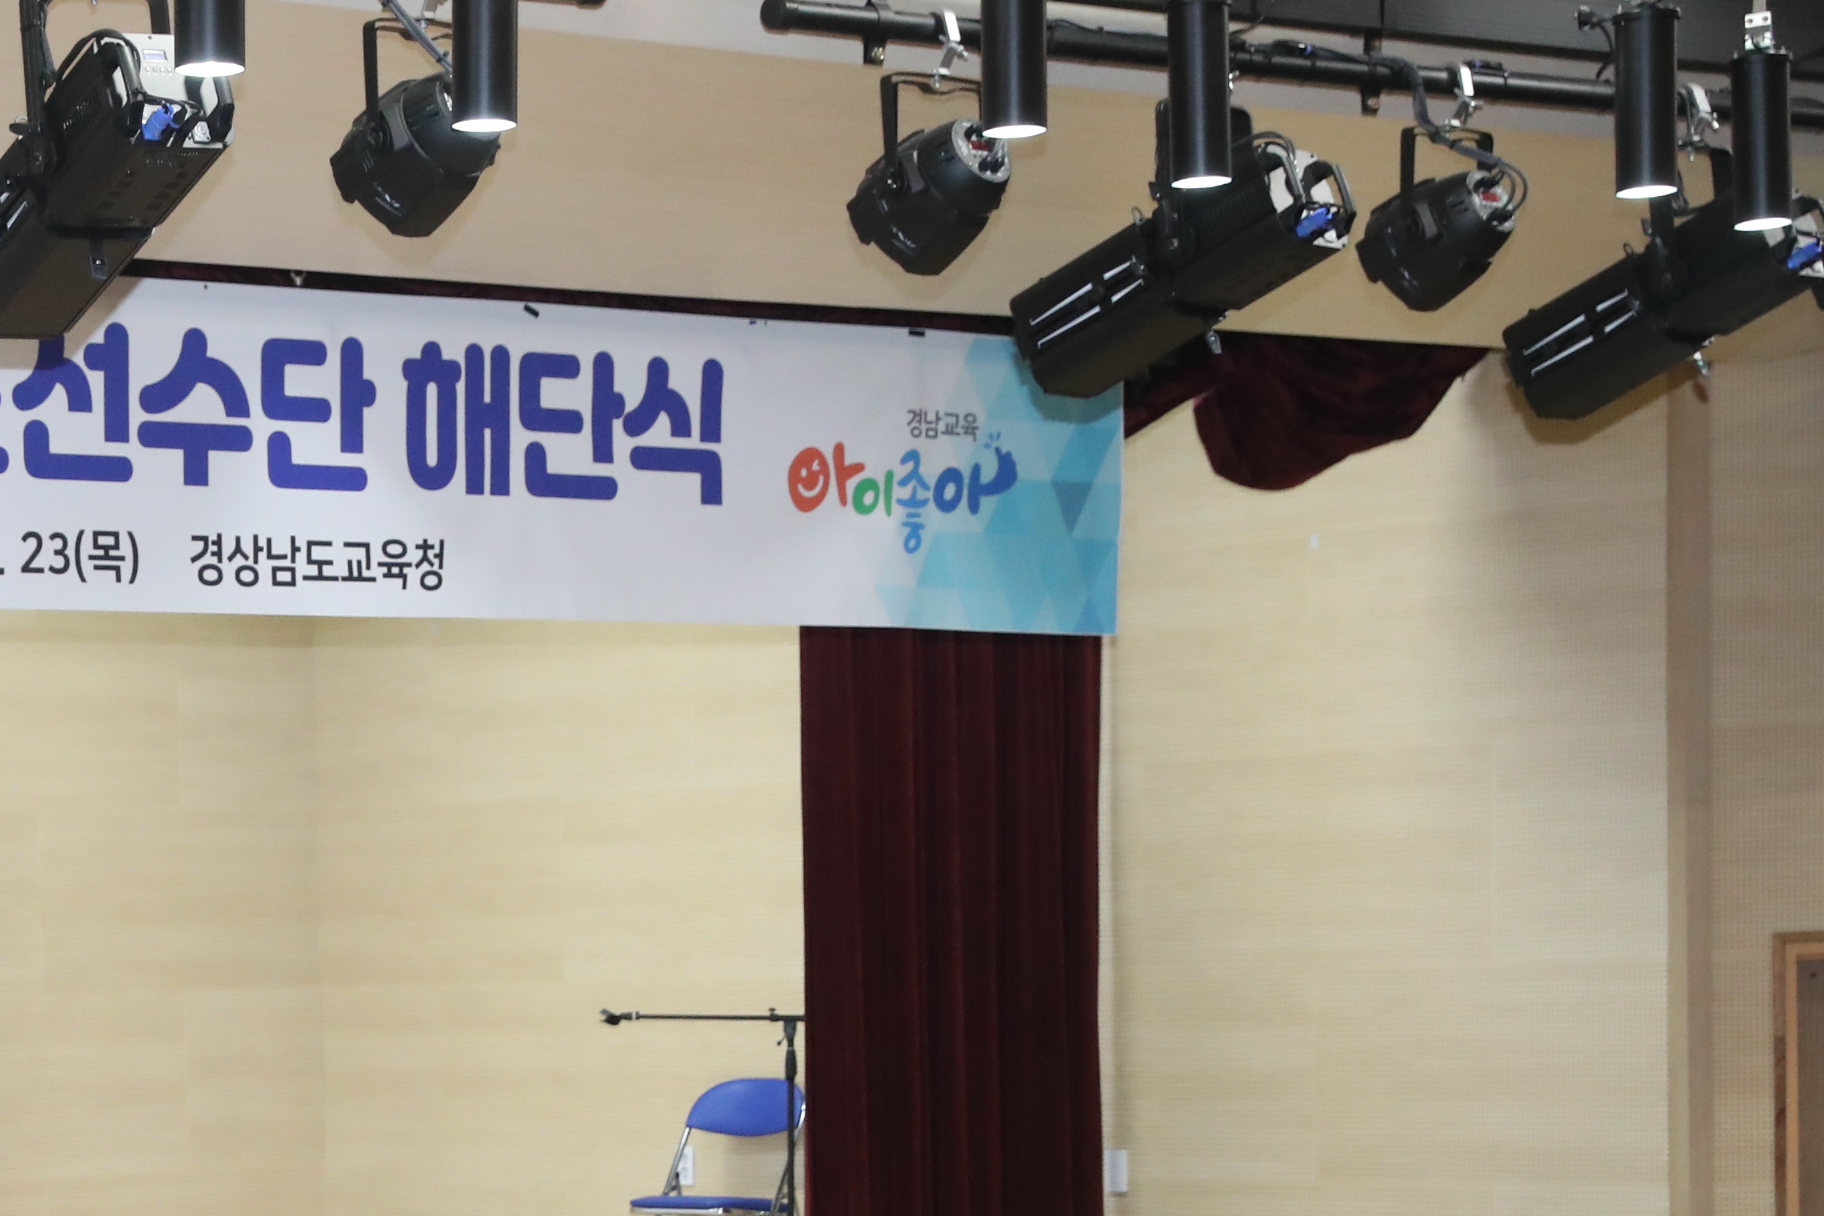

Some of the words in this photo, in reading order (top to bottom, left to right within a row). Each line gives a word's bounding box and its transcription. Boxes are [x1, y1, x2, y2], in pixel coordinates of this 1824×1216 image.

[402, 341, 724, 505] 해단식
[906, 409, 979, 442] 경남교육
[21, 530, 138, 584] 23(목)
[191, 533, 444, 591] 경상남도교육청
